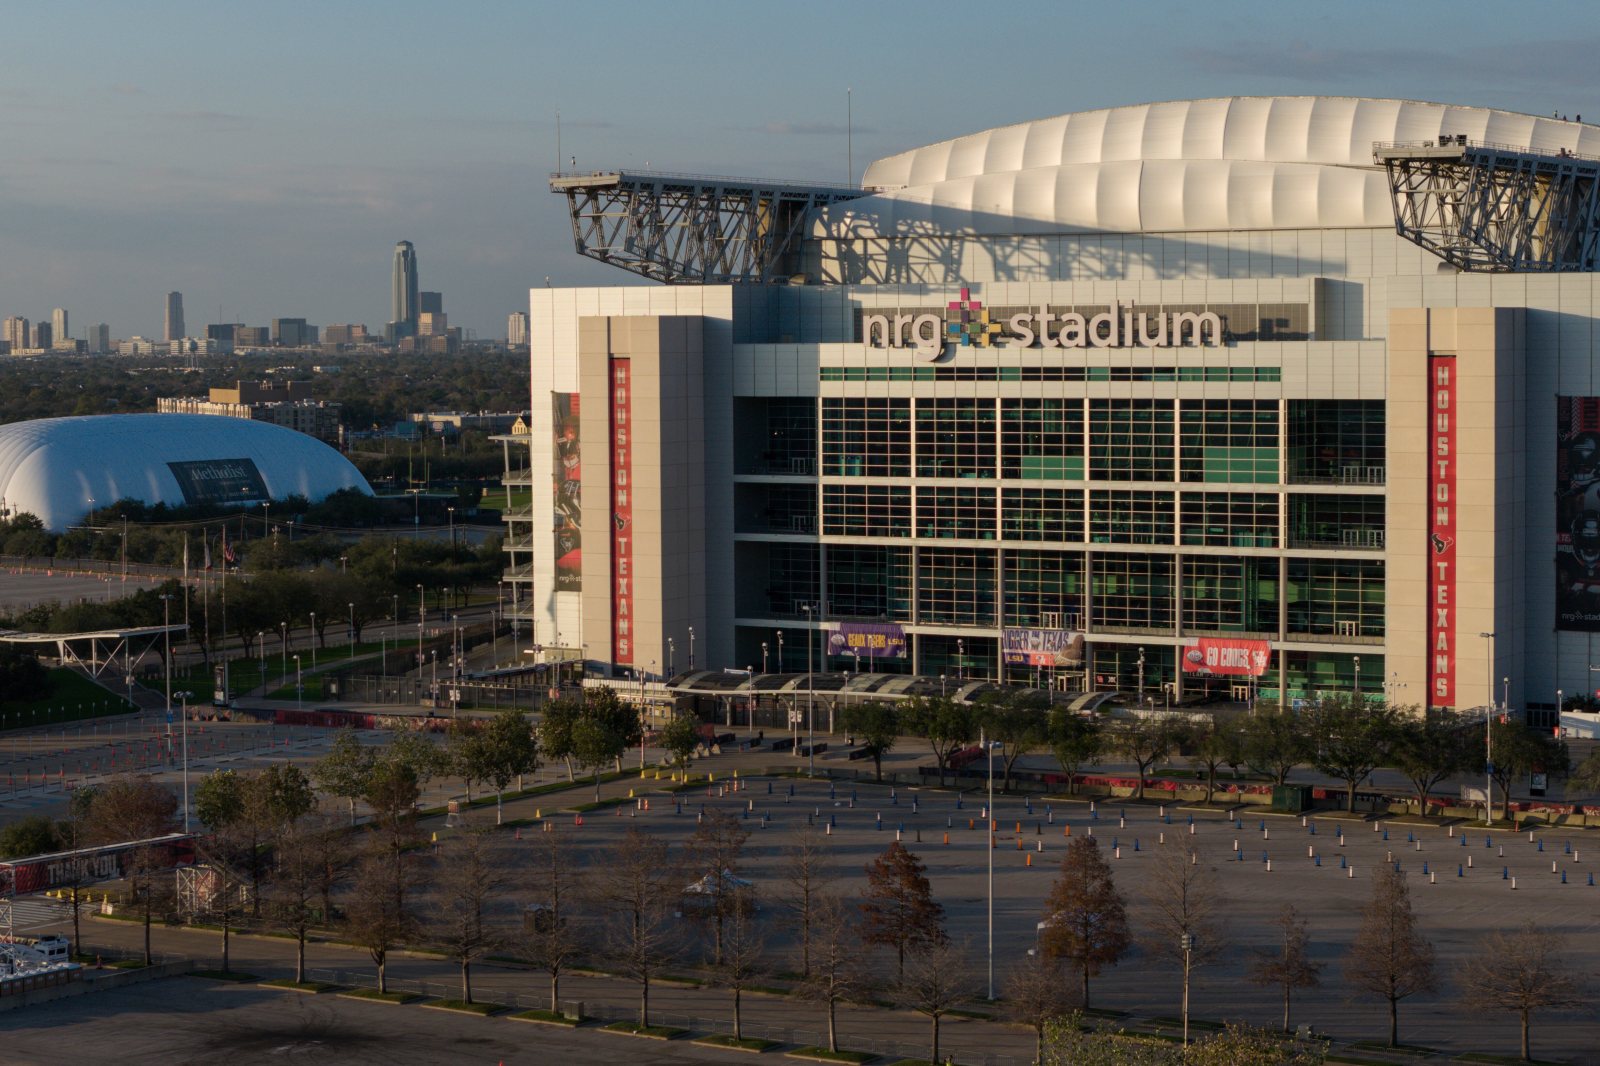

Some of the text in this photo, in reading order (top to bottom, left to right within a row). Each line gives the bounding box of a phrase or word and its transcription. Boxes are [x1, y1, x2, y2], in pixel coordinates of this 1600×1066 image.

[862, 299, 1221, 362] nrg stadium
[191, 464, 248, 481] Methodist
[616, 367, 629, 656] HOUSTON TEXANS
[1436, 366, 1449, 697] HOUSTON TEXANS
[848, 633, 865, 647] GEAUX
[867, 634, 886, 648] TGERS
[1206, 647, 1219, 667] GO
